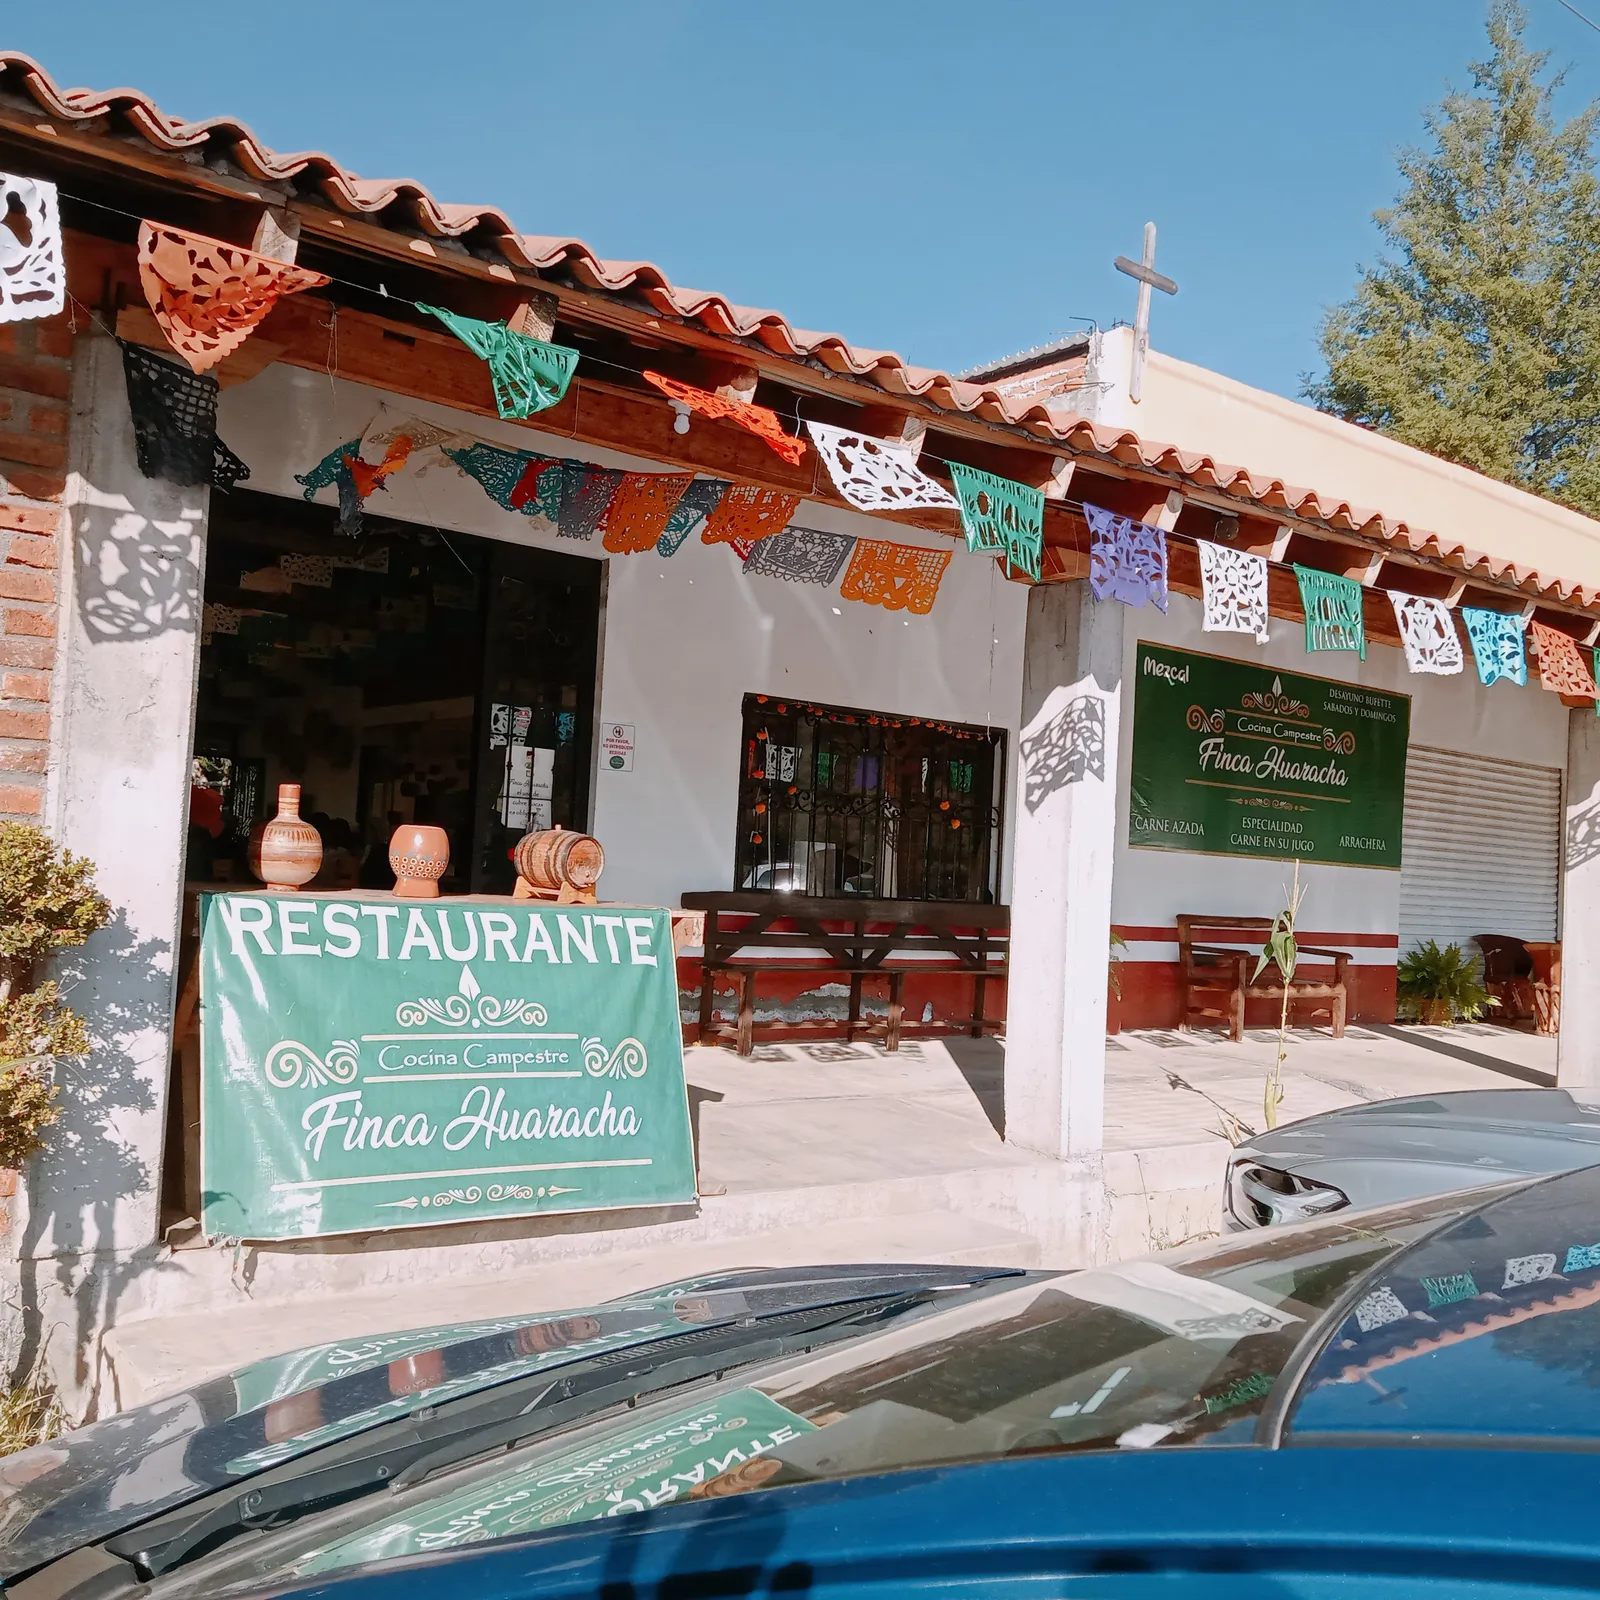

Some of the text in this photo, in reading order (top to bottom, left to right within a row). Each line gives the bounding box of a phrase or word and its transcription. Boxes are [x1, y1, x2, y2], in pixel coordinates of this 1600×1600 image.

[1143, 656, 1190, 686] Mezcal
[1329, 688, 1392, 709] DESAYUNO BUFETTE
[1323, 701, 1396, 723] SABADOS Y DOMINGOS
[1237, 717, 1322, 743] Cocina Campestre
[1199, 737, 1349, 787] Finca Huaracha
[1135, 816, 1205, 836] CARNE AZADA
[1242, 817, 1303, 834] ESPECIALIDAD
[1230, 833, 1315, 852] CARNE EN SU JUGO
[1339, 836, 1386, 851] ARRACHERA
[228, 897, 659, 968] RESTAURANTE
[378, 1043, 570, 1073] Cocina Campestre
[301, 1085, 643, 1162] Finca Huaracha
